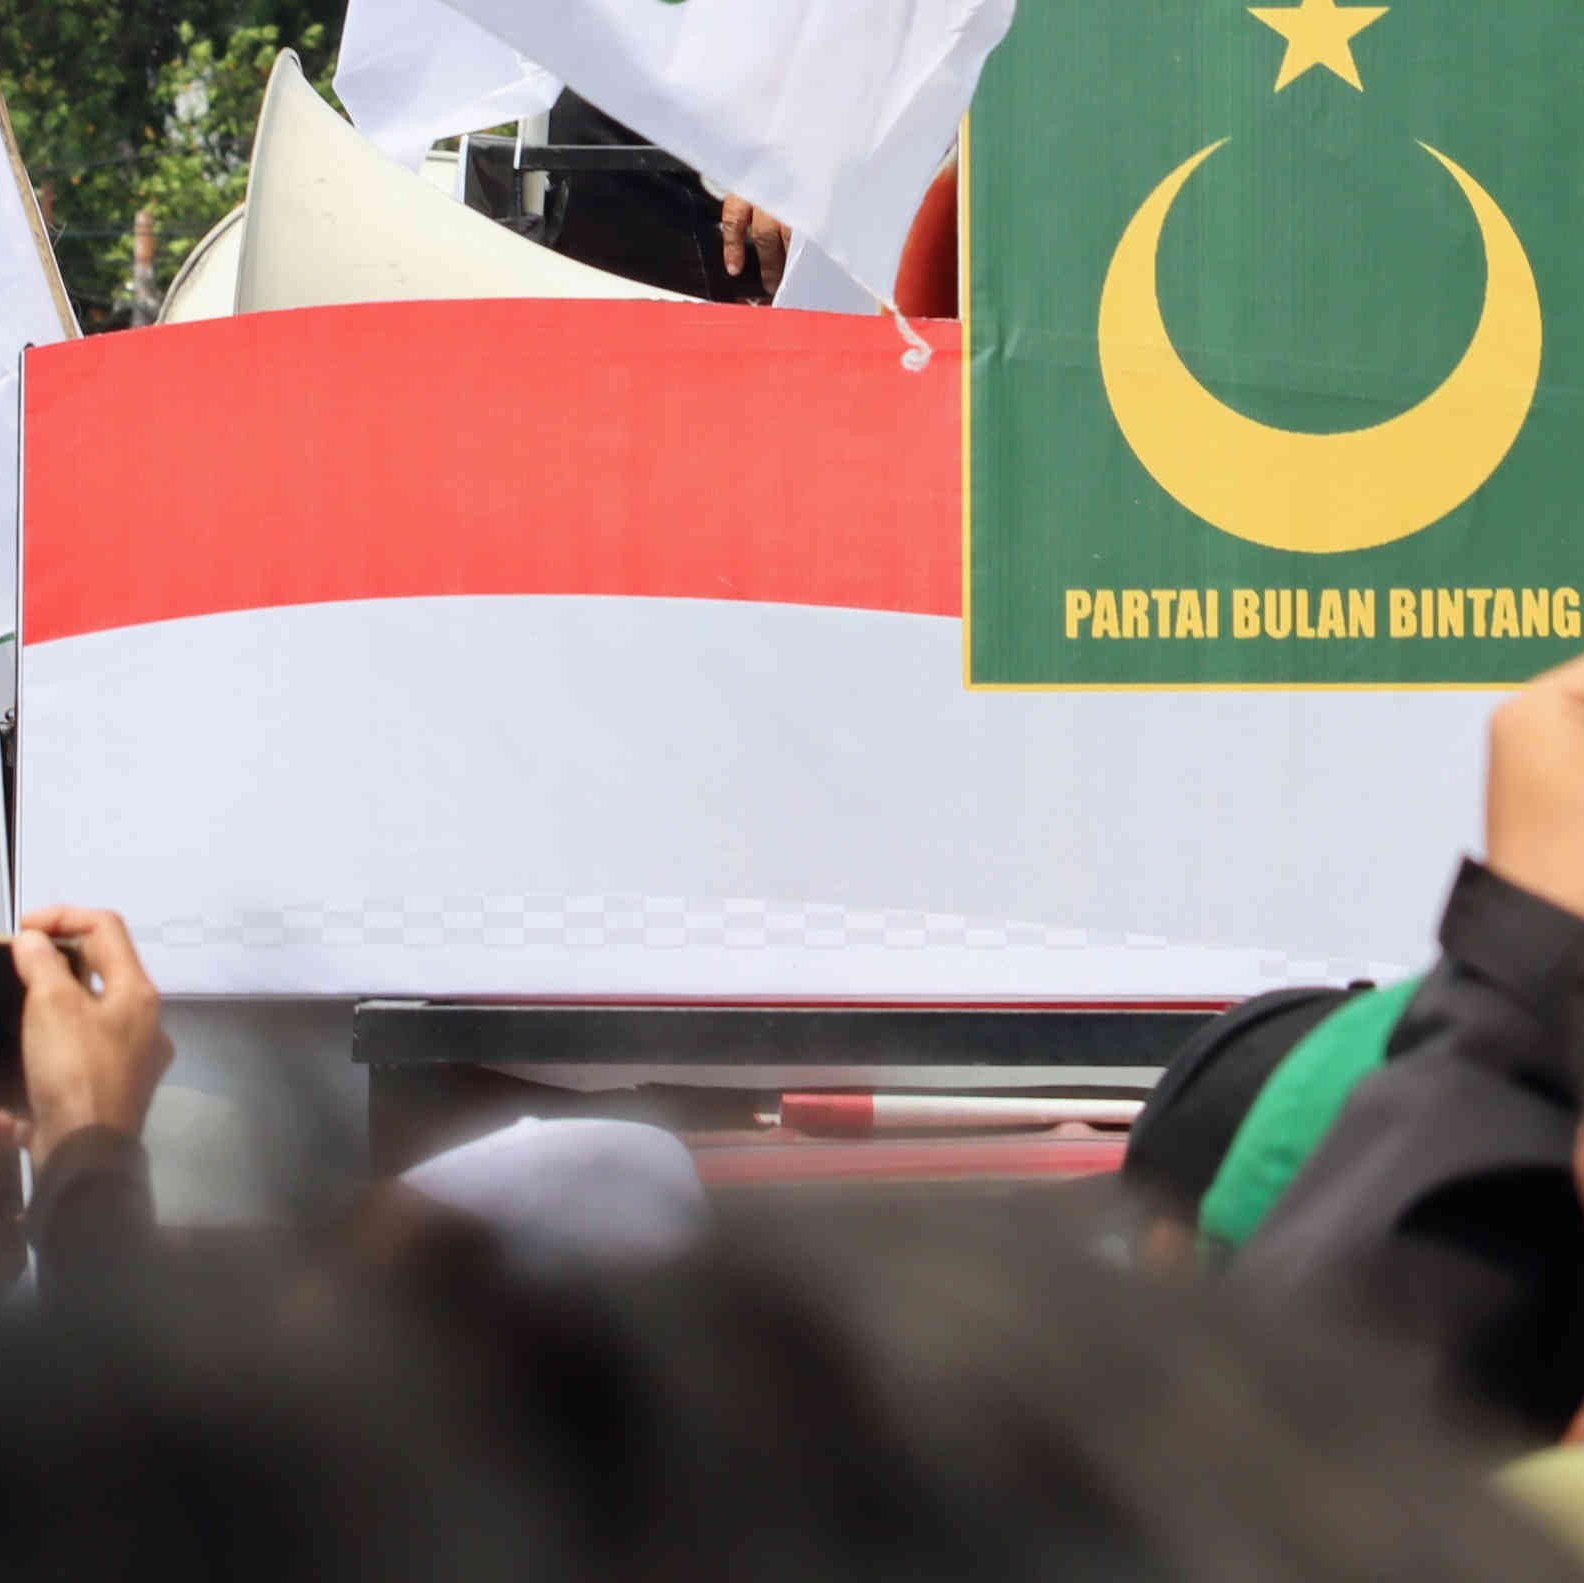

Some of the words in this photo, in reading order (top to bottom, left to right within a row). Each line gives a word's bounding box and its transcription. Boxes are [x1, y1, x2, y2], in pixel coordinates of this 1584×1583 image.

[1065, 588, 1219, 639] PARTAI
[1232, 588, 1376, 639] BULAN
[1389, 586, 1582, 639] BINTANG
